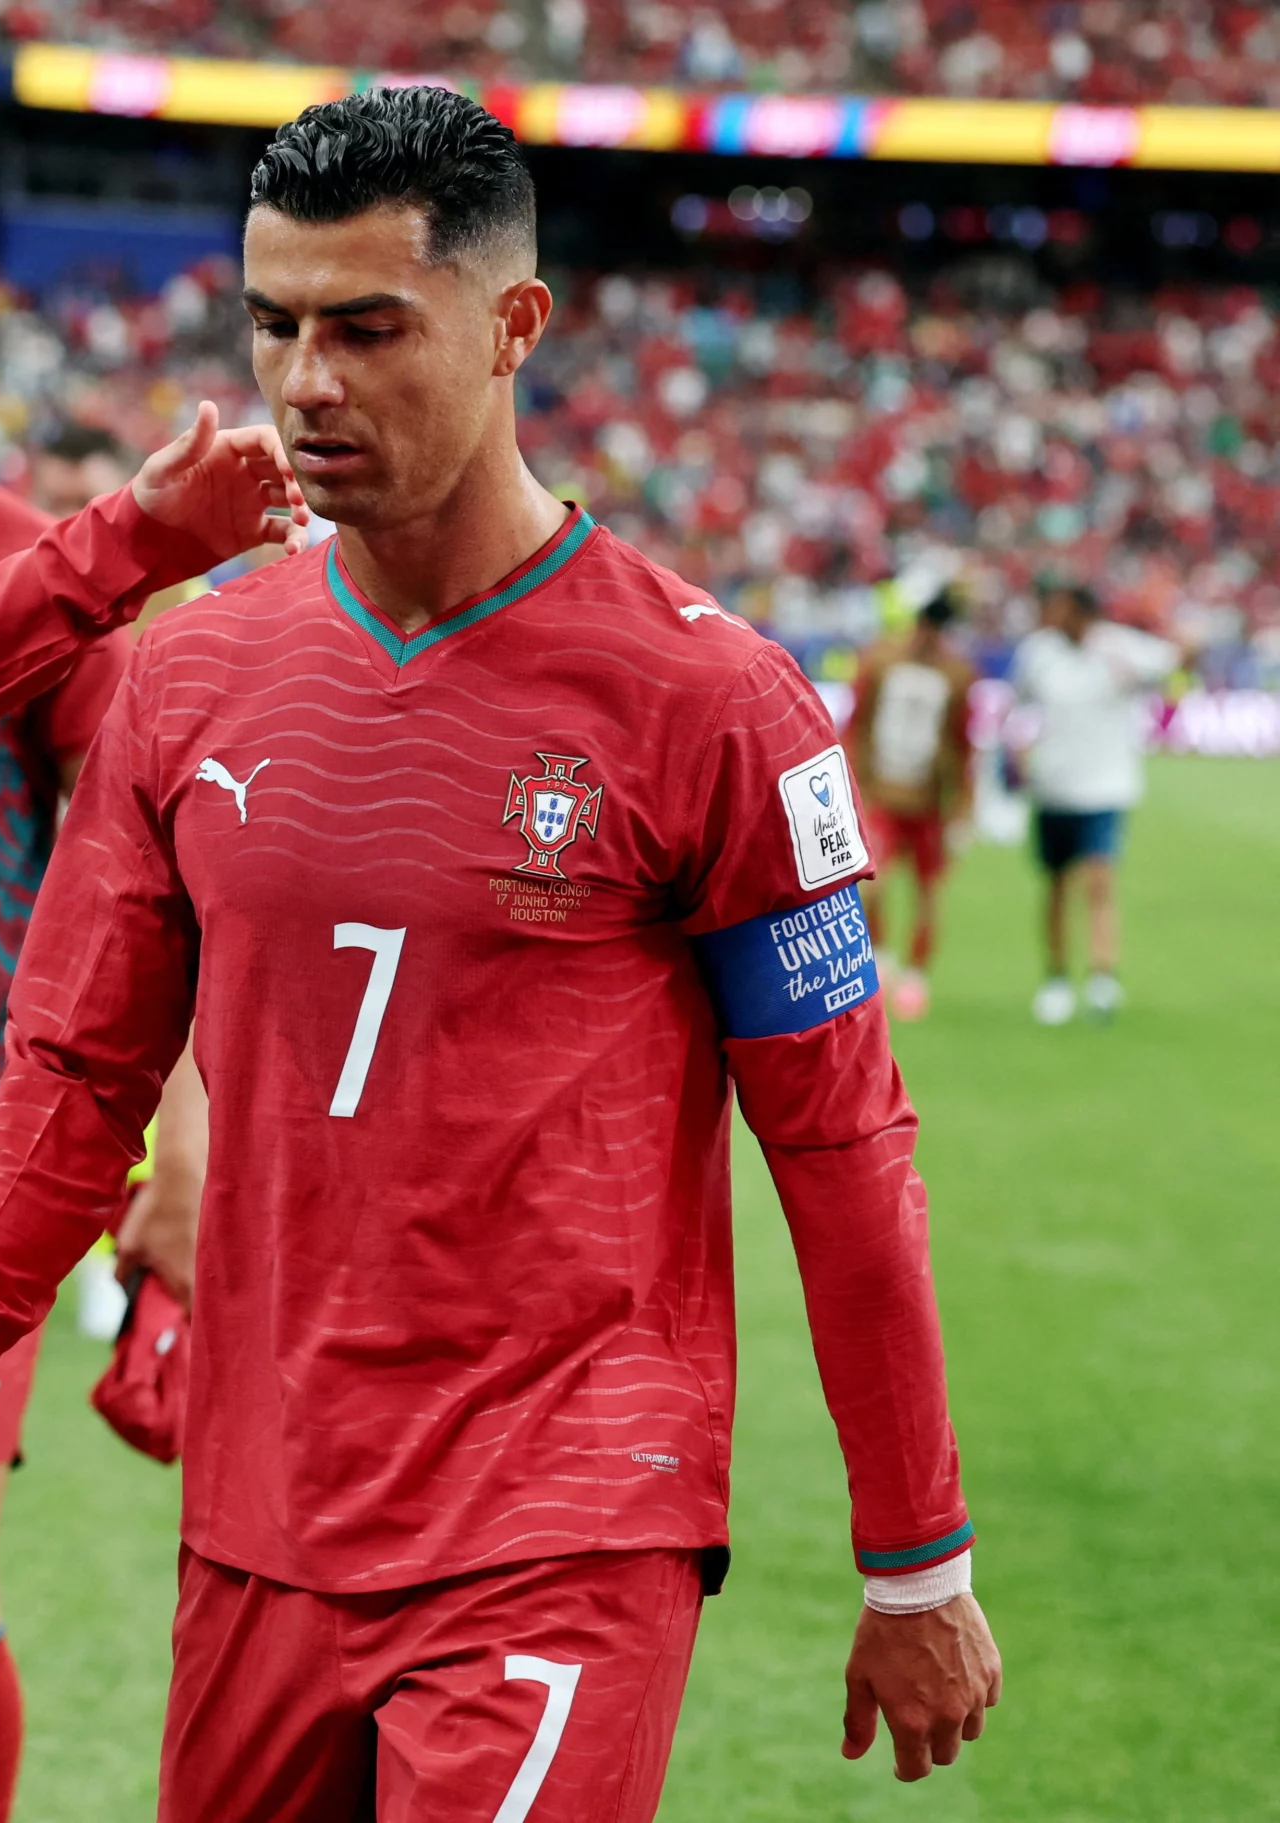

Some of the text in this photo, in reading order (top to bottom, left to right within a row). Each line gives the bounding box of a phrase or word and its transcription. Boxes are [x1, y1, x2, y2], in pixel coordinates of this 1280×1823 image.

[814, 812, 837, 836] Unite
[820, 826, 851, 857] PEAC
[831, 851, 852, 867] FIFA
[489, 878, 591, 898] PORTUGAL/CONGO
[496, 893, 581, 910] 17 JUNHO 2026
[510, 907, 567, 923] HOUSTON
[769, 887, 856, 944] FOOTBALL
[777, 908, 865, 972] UNITES
[783, 935, 874, 1002] the World
[829, 983, 862, 1008] FIFA
[328, 922, 407, 1118] 7
[492, 1654, 583, 1823] 7
